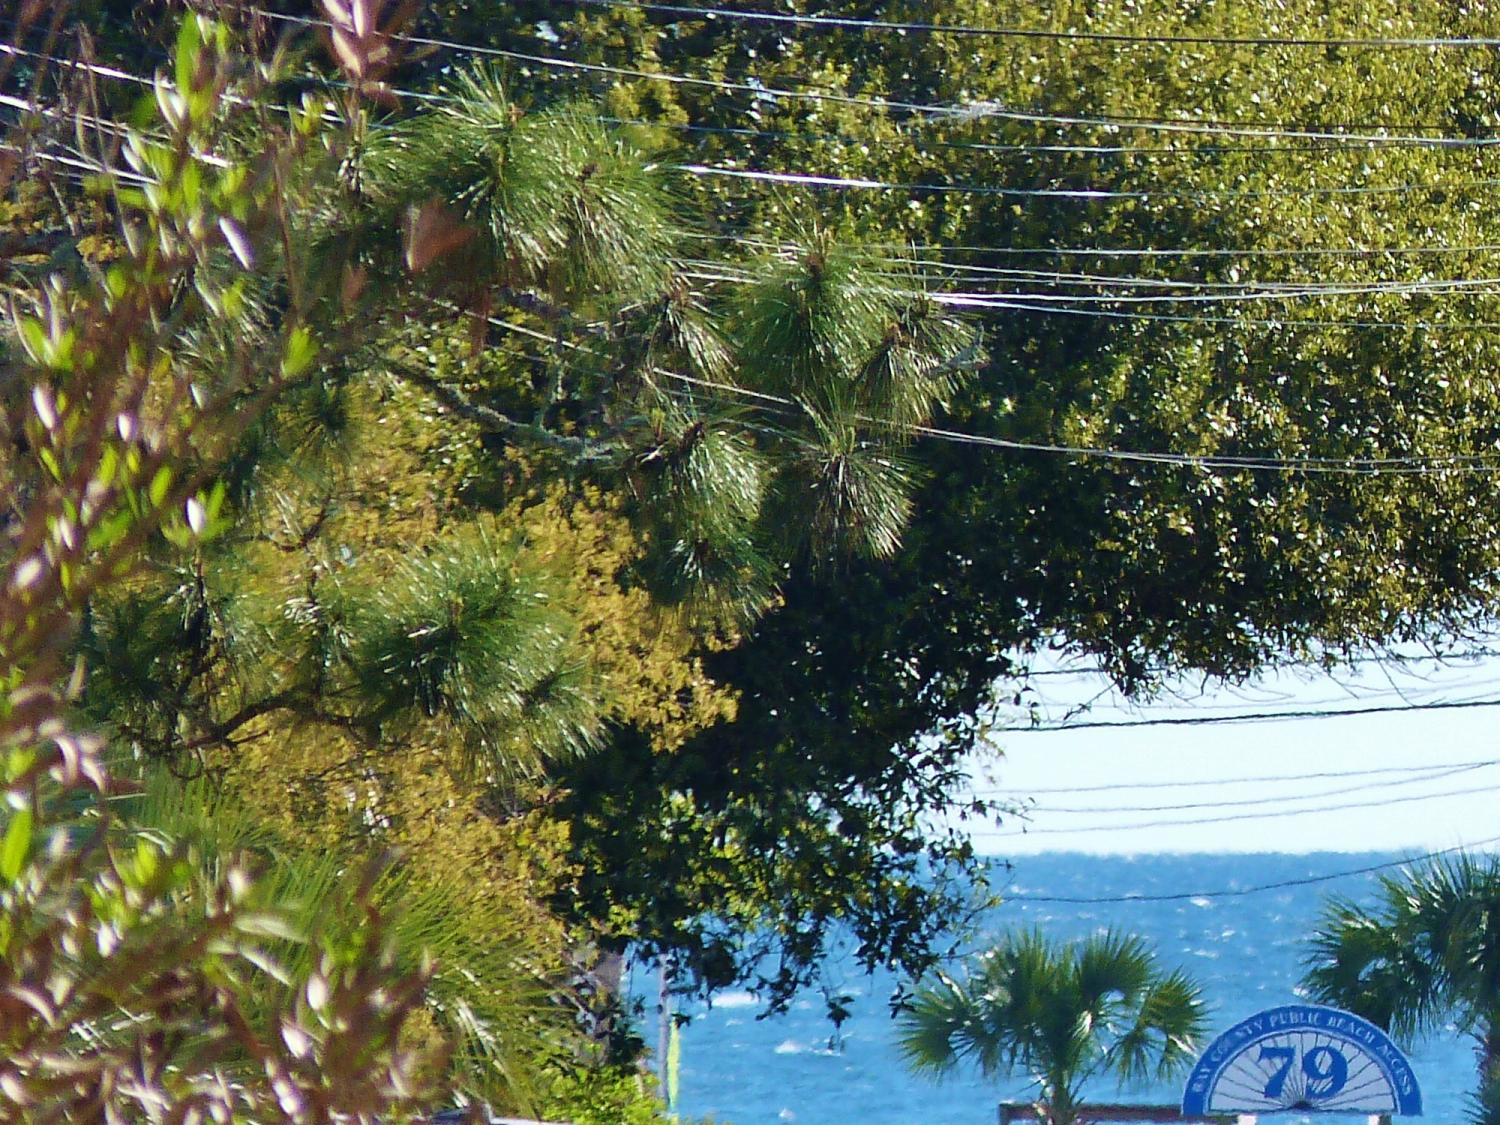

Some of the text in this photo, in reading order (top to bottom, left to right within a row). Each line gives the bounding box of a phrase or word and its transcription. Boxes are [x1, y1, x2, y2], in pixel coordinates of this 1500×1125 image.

[1210, 1018, 1264, 1063] COTY
[1269, 1012, 1320, 1028] PUBLIC
[1326, 1016, 1376, 1044] BEACH
[1375, 1043, 1412, 1096] ACCESS
[1257, 1045, 1348, 1100] 79
